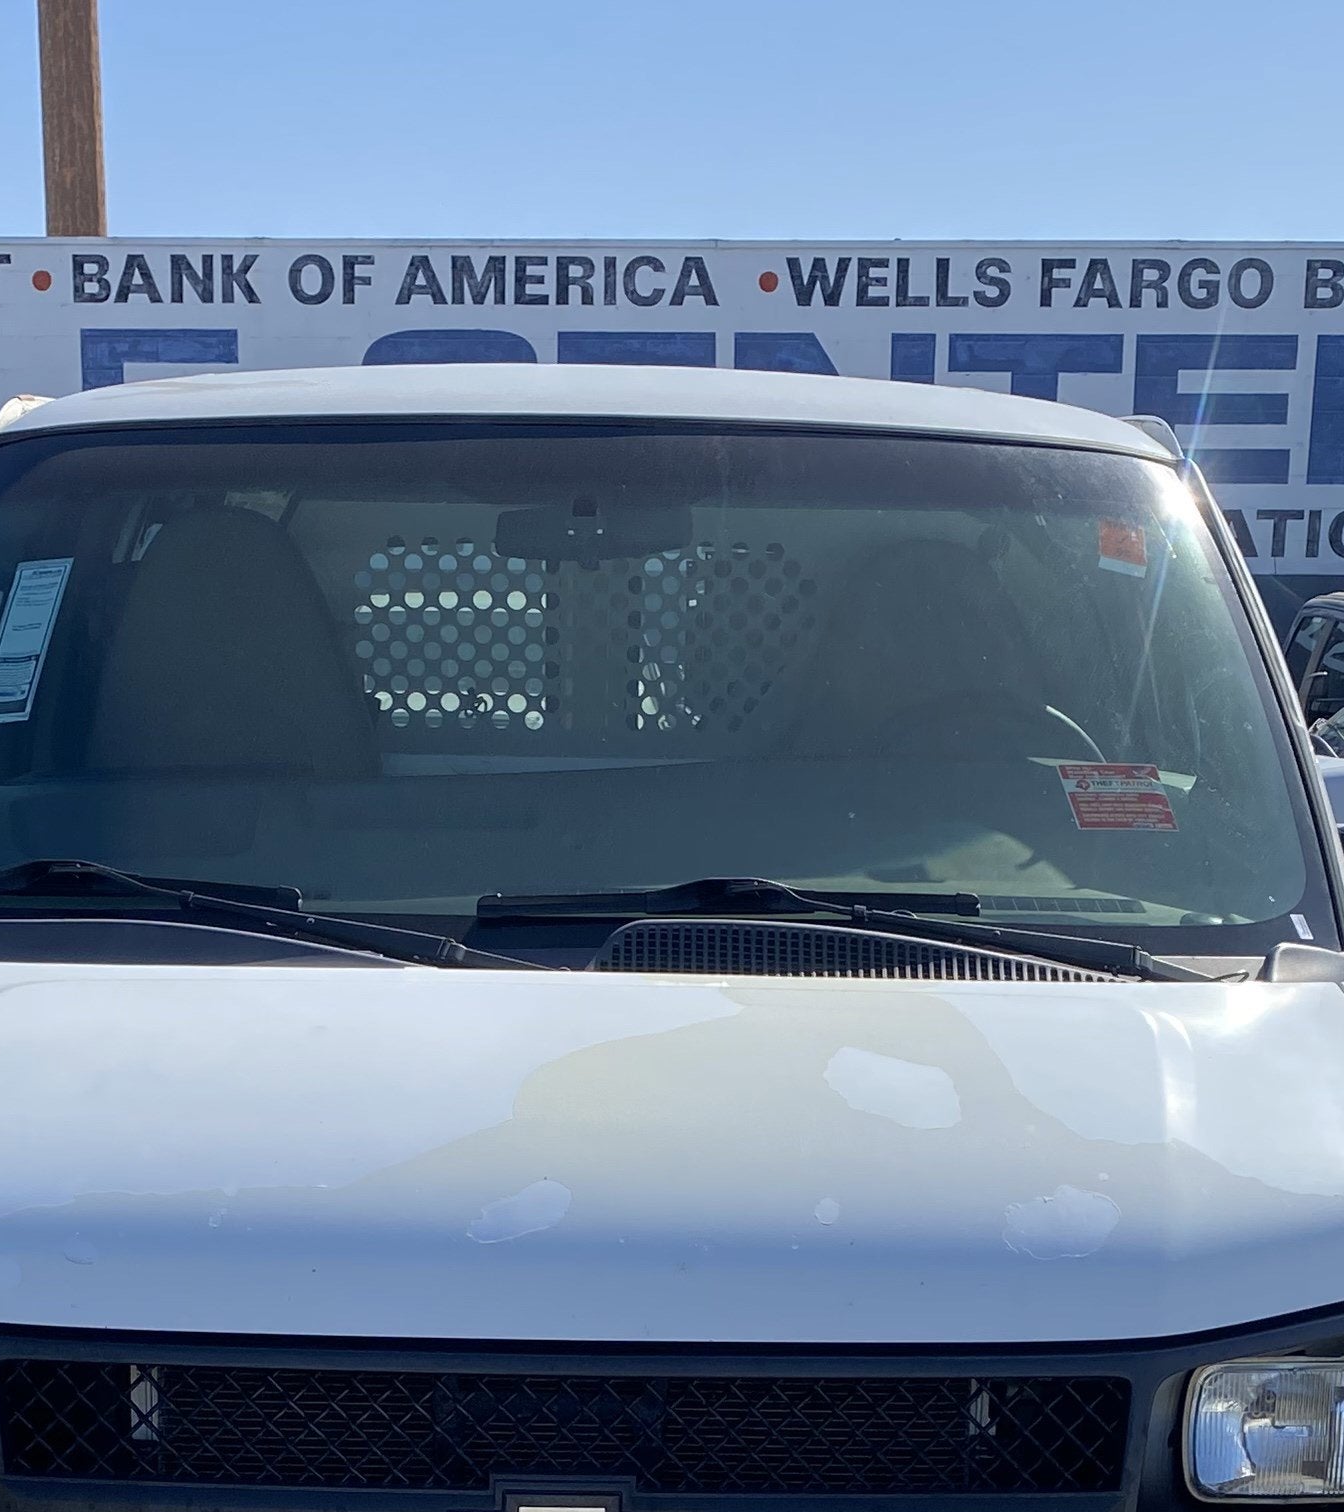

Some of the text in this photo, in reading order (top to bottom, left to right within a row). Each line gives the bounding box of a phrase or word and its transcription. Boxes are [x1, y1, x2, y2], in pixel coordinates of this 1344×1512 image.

[71, 253, 262, 305] BANK
[288, 254, 376, 306] OF
[394, 254, 720, 307] AMERICA
[786, 256, 1012, 308] WELLS
[1039, 257, 1275, 310] FARGO
